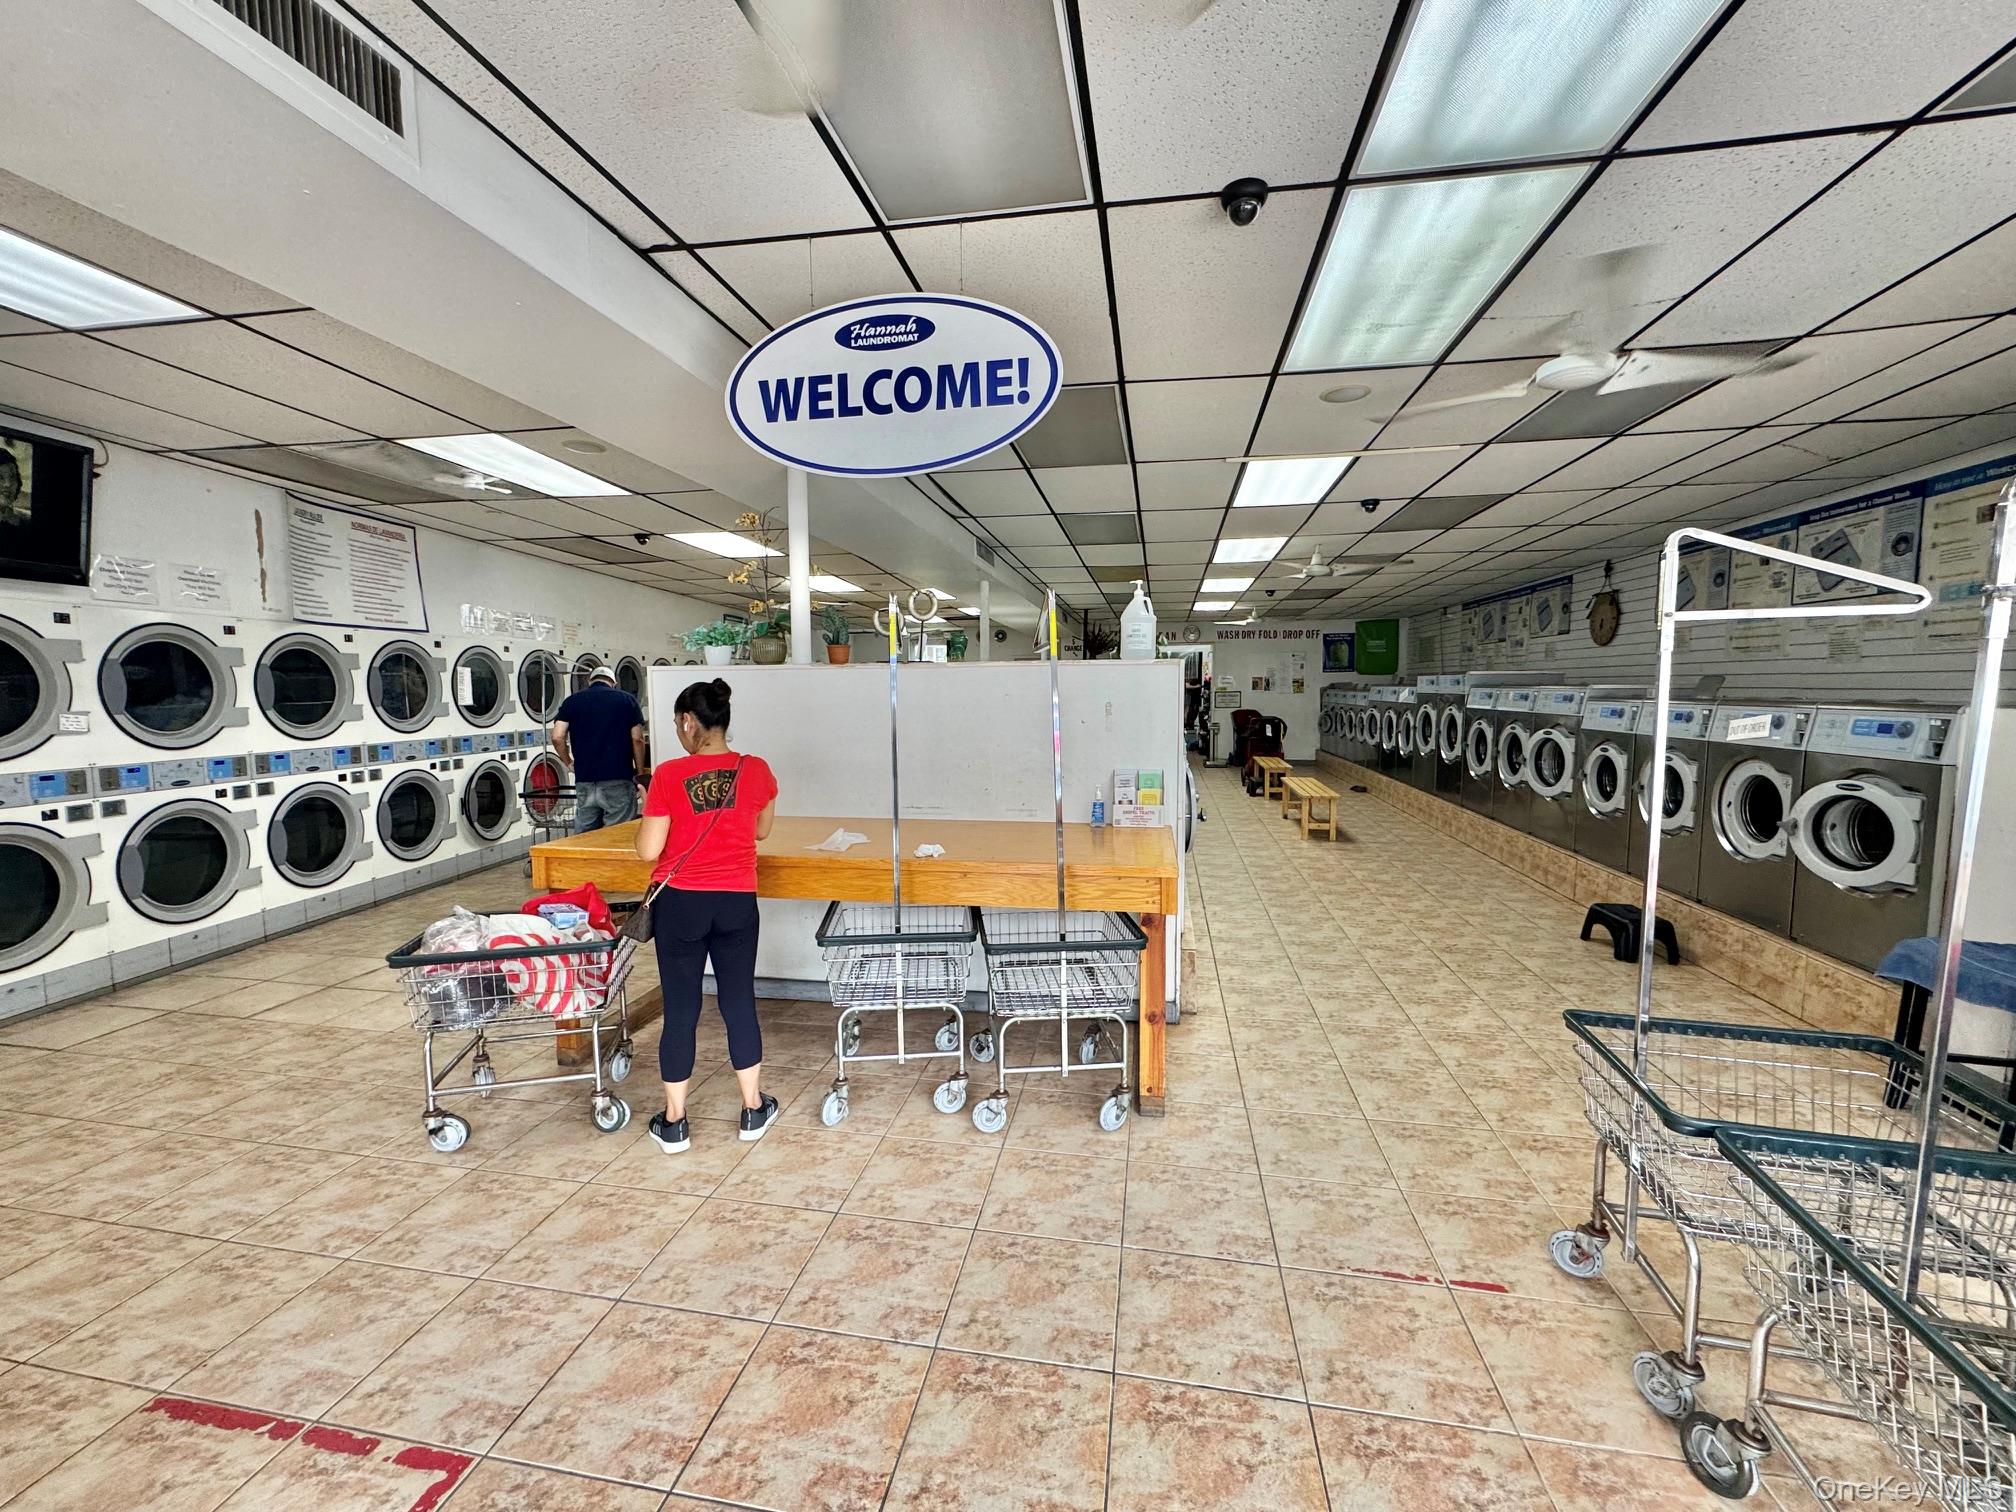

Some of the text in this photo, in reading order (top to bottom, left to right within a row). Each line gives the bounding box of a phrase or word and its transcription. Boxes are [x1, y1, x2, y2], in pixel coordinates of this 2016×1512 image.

[850, 316, 917, 339] Hannah
[850, 333, 919, 347] LAUNDROMAT
[758, 357, 1031, 424] WELCOME!
[1217, 629, 1240, 640] WASH
[1241, 630, 1256, 640] DRY
[1258, 630, 1278, 640] FOLD
[1282, 629, 1303, 640] DROP
[1305, 629, 1321, 640] OFF
[1729, 725, 1740, 736] OUT
